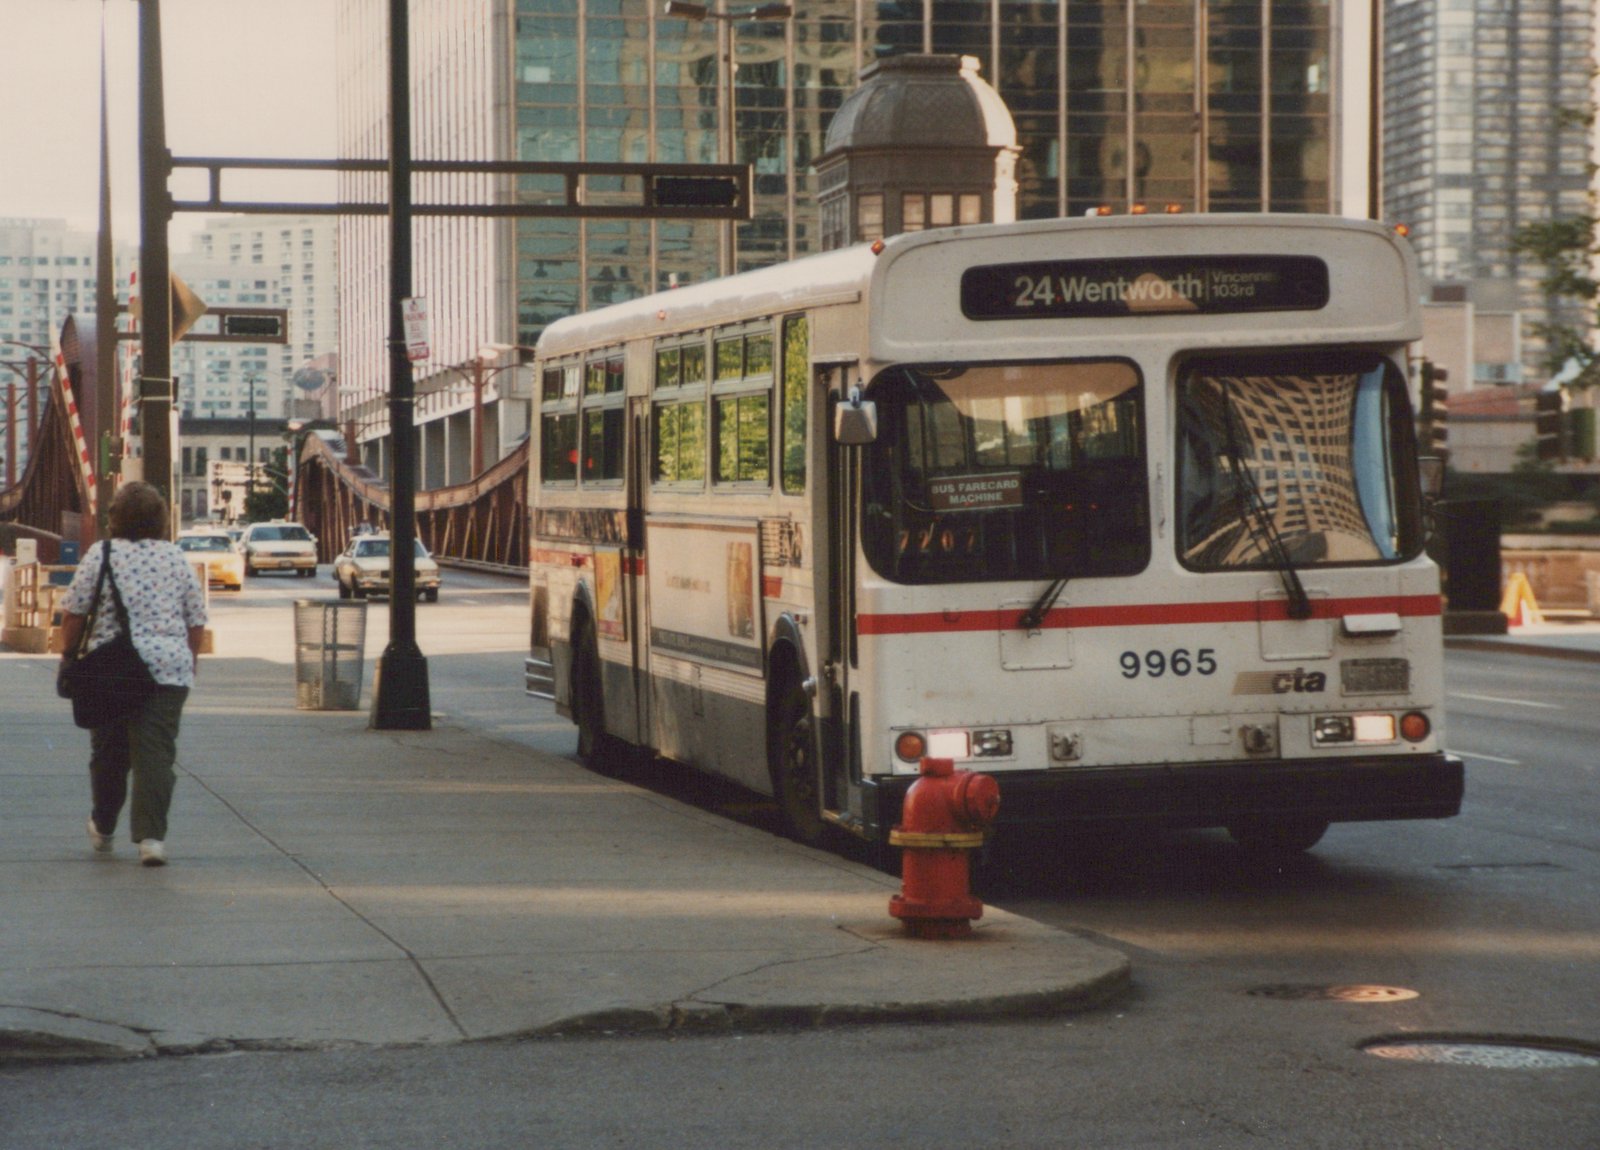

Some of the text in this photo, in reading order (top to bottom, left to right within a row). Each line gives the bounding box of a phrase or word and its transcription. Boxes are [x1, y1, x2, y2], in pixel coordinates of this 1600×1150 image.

[1014, 272, 1202, 307] 24 Wentworth
[1211, 283, 1256, 298] 103rd
[931, 480, 1020, 495] BUS FARECARD
[949, 492, 1004, 505] MACHINE
[1119, 648, 1218, 680] 9965
[1271, 667, 1327, 694] cta
